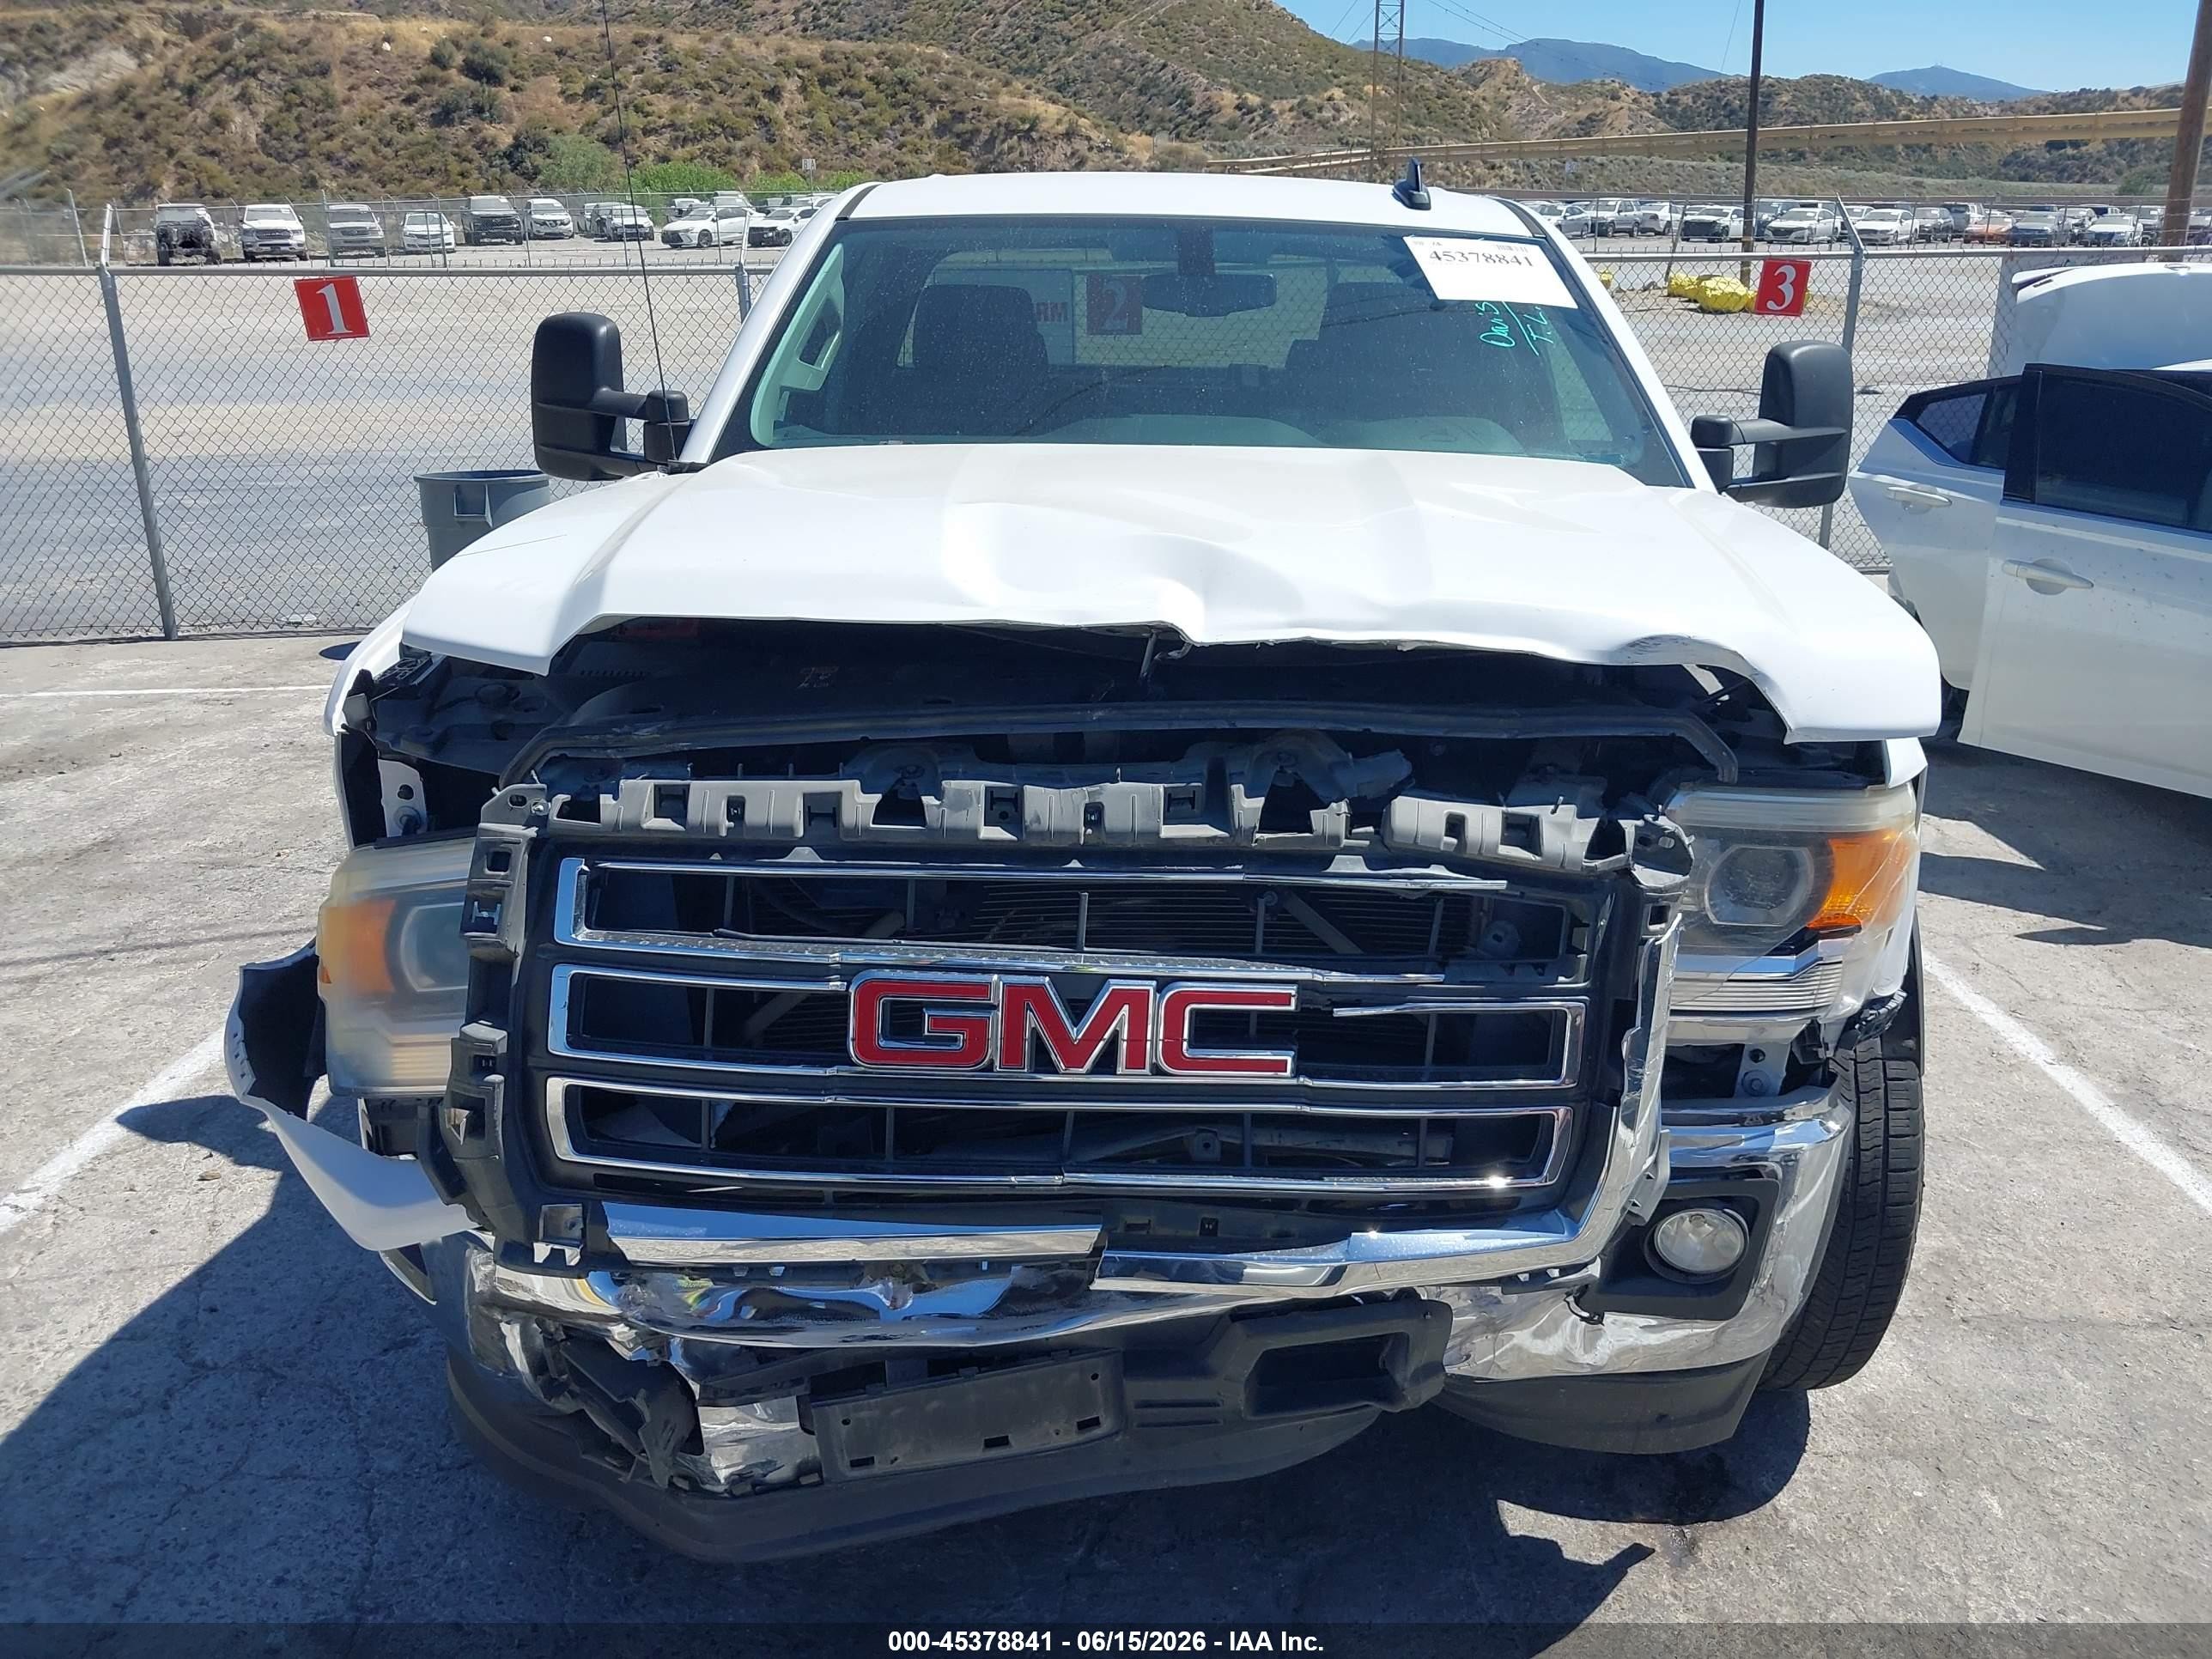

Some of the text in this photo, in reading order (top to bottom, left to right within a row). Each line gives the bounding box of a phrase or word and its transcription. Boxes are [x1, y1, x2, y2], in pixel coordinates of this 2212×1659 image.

[1429, 250, 1534, 267] 45378841
[316, 283, 353, 334] 1
[1101, 279, 1127, 331] 2
[1766, 264, 1796, 311] 3
[849, 969, 1297, 1078] GMC
